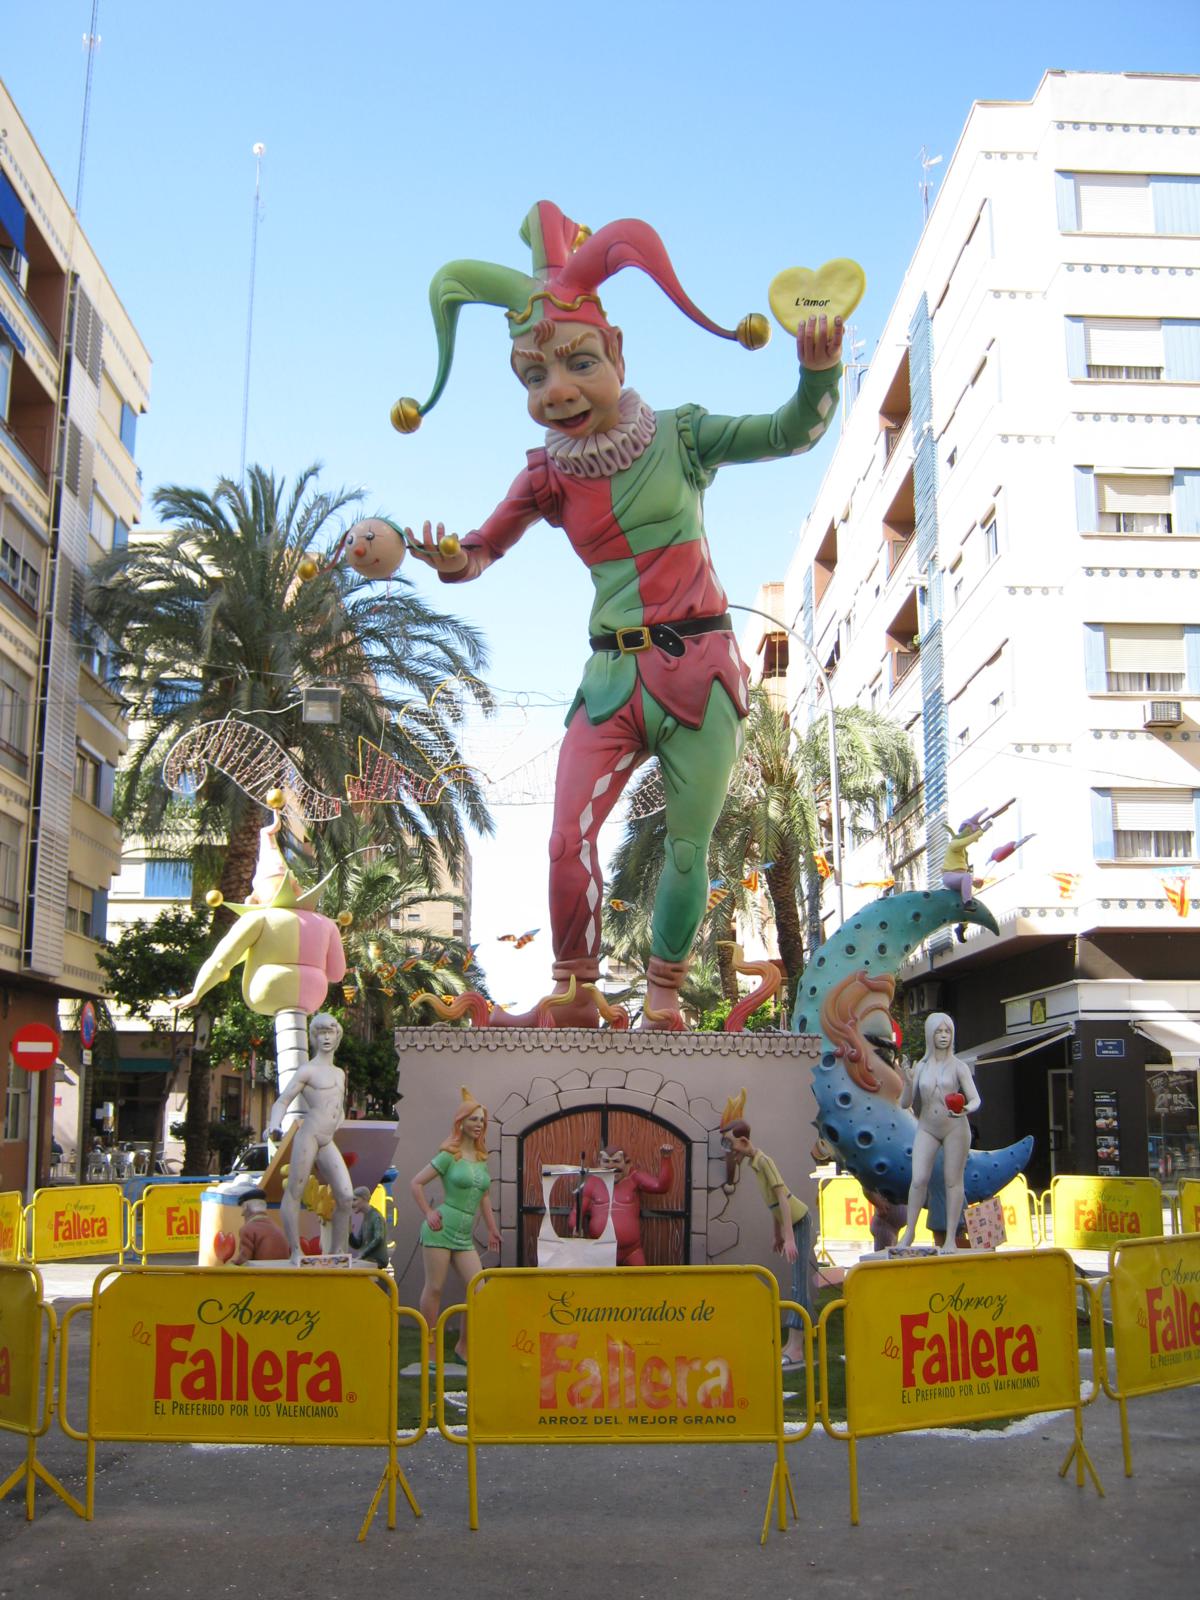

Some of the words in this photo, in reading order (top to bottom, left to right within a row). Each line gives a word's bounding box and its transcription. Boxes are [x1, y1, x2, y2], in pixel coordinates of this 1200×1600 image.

[795, 297, 830, 307] L'amor
[53, 1210, 108, 1242] Fallera
[1074, 1199, 1141, 1234] Fallera
[197, 1291, 321, 1341] Arroz
[542, 1290, 686, 1325] Enamorados
[691, 1299, 715, 1321] de
[928, 1282, 1007, 1321] Arroz
[131, 1320, 152, 1347] la
[154, 1323, 344, 1403] Fallera
[900, 1311, 1039, 1389] Fallera
[511, 1329, 536, 1355] la
[539, 1331, 735, 1410] Fallera
[538, 1415, 588, 1425] ARROZ
[594, 1415, 622, 1425] DEL
[628, 1415, 678, 1425] MEJOR
[683, 1415, 737, 1425] GRANO
